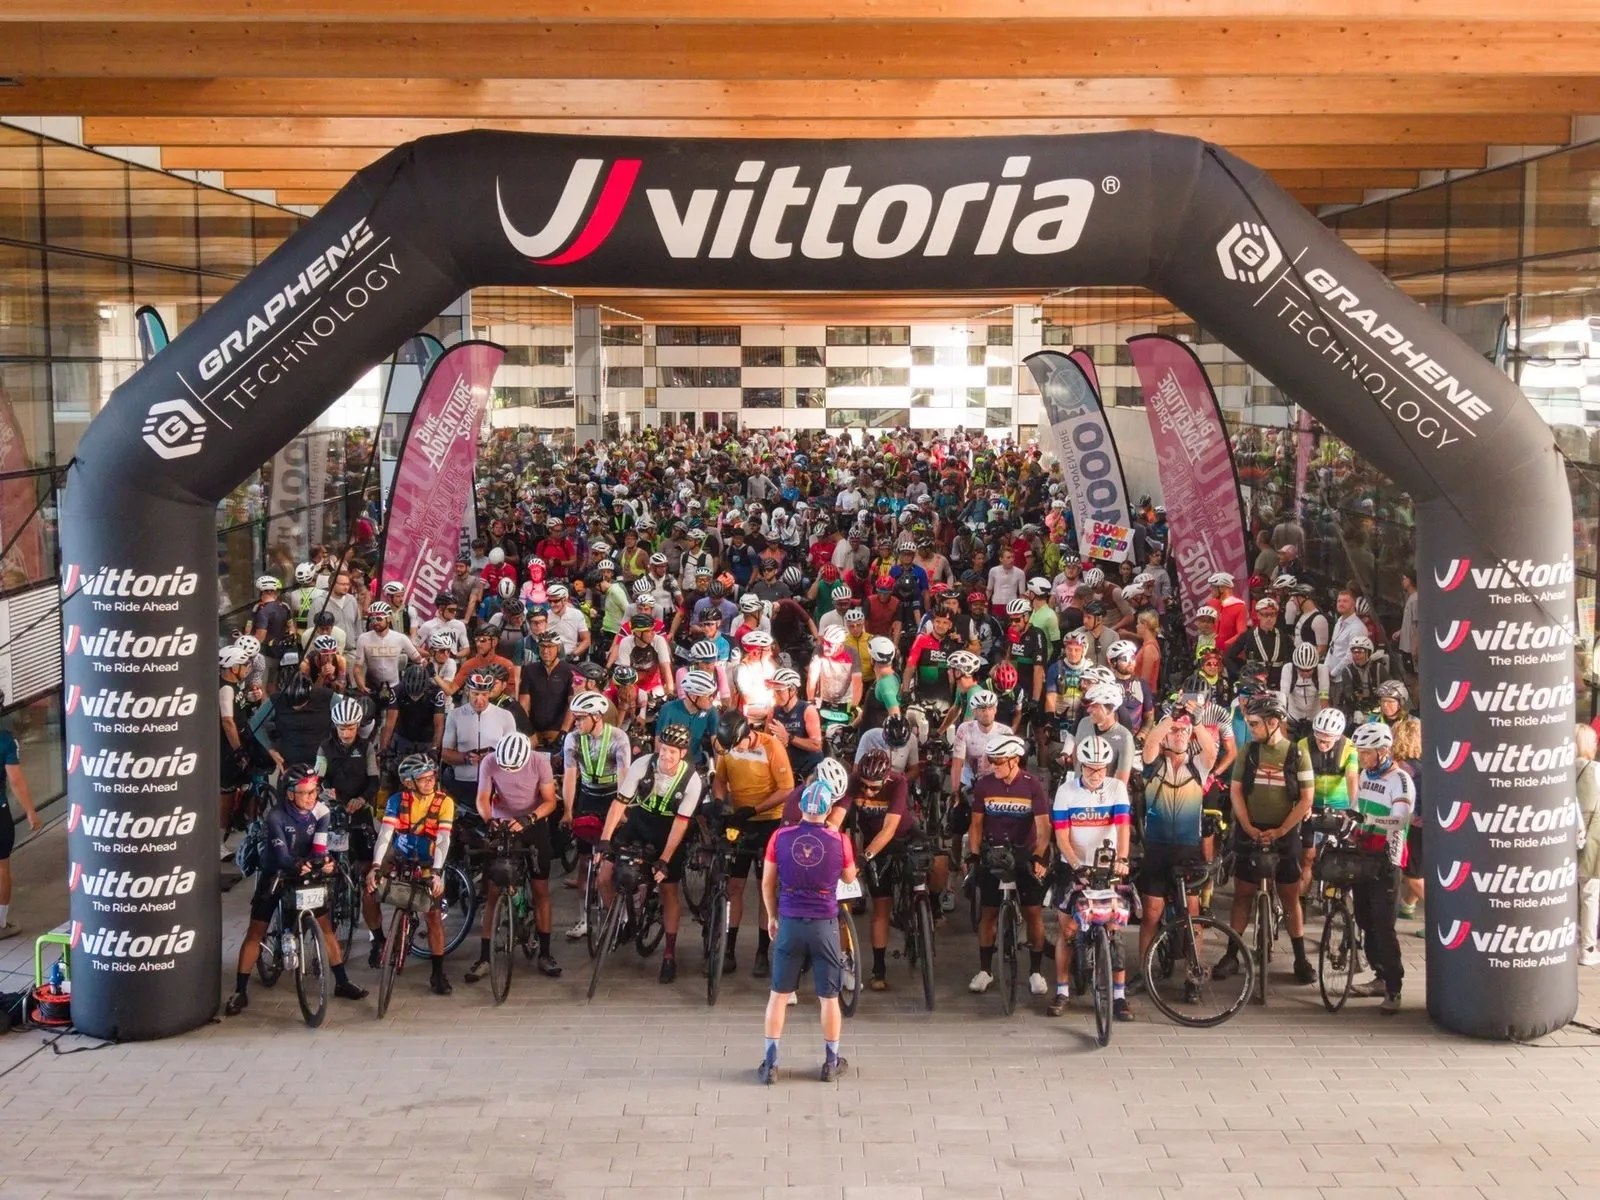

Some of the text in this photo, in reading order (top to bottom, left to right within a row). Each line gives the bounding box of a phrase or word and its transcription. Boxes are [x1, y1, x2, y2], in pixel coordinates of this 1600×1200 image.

[645, 156, 1095, 260] vittoria
[199, 217, 374, 381] GRAPHENE
[223, 253, 401, 411] TECHNOLOGY
[1305, 269, 1492, 421] GRAPHENE
[1277, 297, 1459, 449] TECHNOLOGY
[414, 412, 440, 444] BIKE
[420, 379, 473, 471] ADVENTURE
[456, 400, 481, 441] SERIES
[80, 566, 198, 597] vittoria
[1488, 594, 1512, 604] The
[1540, 590, 1567, 601] Ahead
[92, 601, 179, 612] The Ride Ahead
[80, 627, 198, 658] vittoria
[1471, 614, 1575, 651] vittoria
[92, 661, 179, 673] The Ride Ahead
[930, 650, 947, 658] RSC
[1488, 651, 1567, 666] The Ride Ahead
[80, 687, 198, 718] vittoria
[1471, 675, 1575, 712] vittoria
[92, 722, 179, 734] The Ride Ahead
[1488, 712, 1567, 727] The Ride Ahead
[81, 747, 197, 779] vittoria
[1471, 736, 1575, 773] vittoria
[92, 782, 178, 794] The Ride Ahead
[1488, 773, 1567, 788] The Ride Ahead
[81, 806, 197, 839] vittoria
[1471, 796, 1576, 834] vittoria
[92, 841, 177, 853] The Ride Ahead
[1488, 833, 1567, 849] The Ride Ahead
[81, 865, 196, 898] vittoria
[1471, 856, 1576, 894] vittoria
[92, 900, 176, 913] The Ride Ahead
[1488, 892, 1567, 909] The Ride Ahead
[81, 925, 196, 957] vittoria
[1471, 917, 1576, 954] vittoria
[91, 959, 175, 972] The Ride Ahead
[1488, 952, 1567, 968] The Ride Ahead
